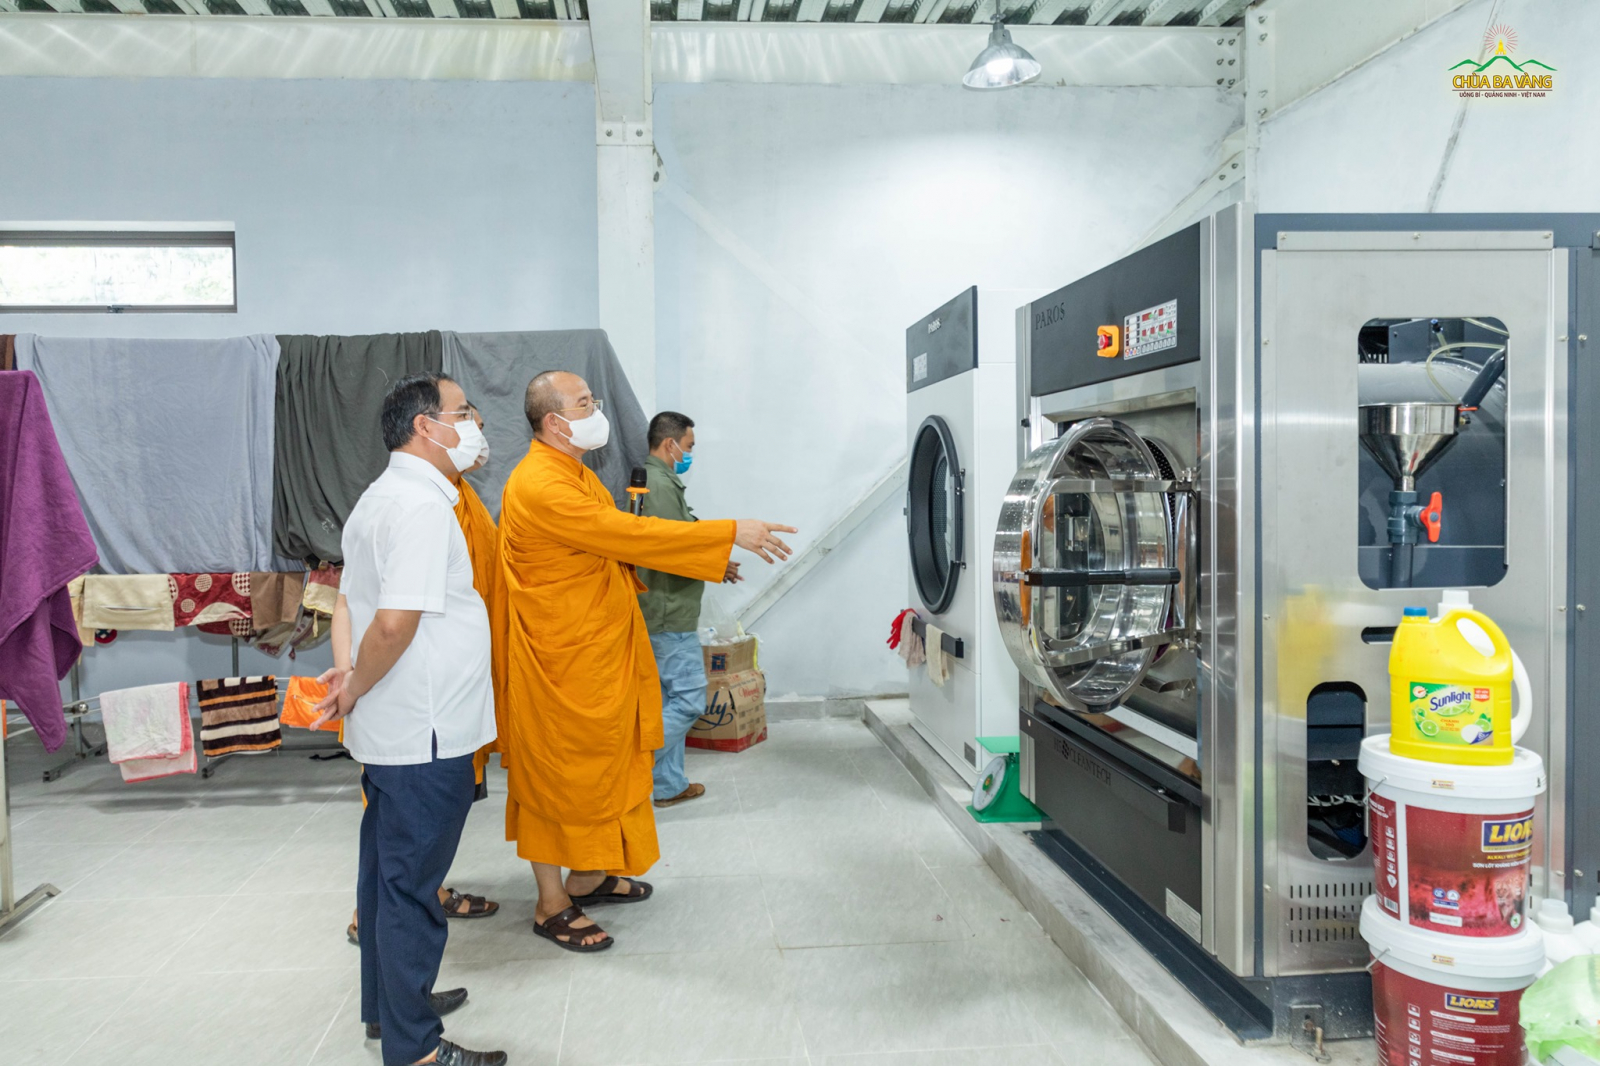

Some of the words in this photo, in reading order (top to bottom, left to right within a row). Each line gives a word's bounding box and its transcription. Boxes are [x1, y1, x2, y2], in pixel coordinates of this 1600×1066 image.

[1035, 302, 1065, 330] PAROS
[1430, 691, 1471, 711] Sunlight
[1450, 996, 1496, 1009] LIONS
